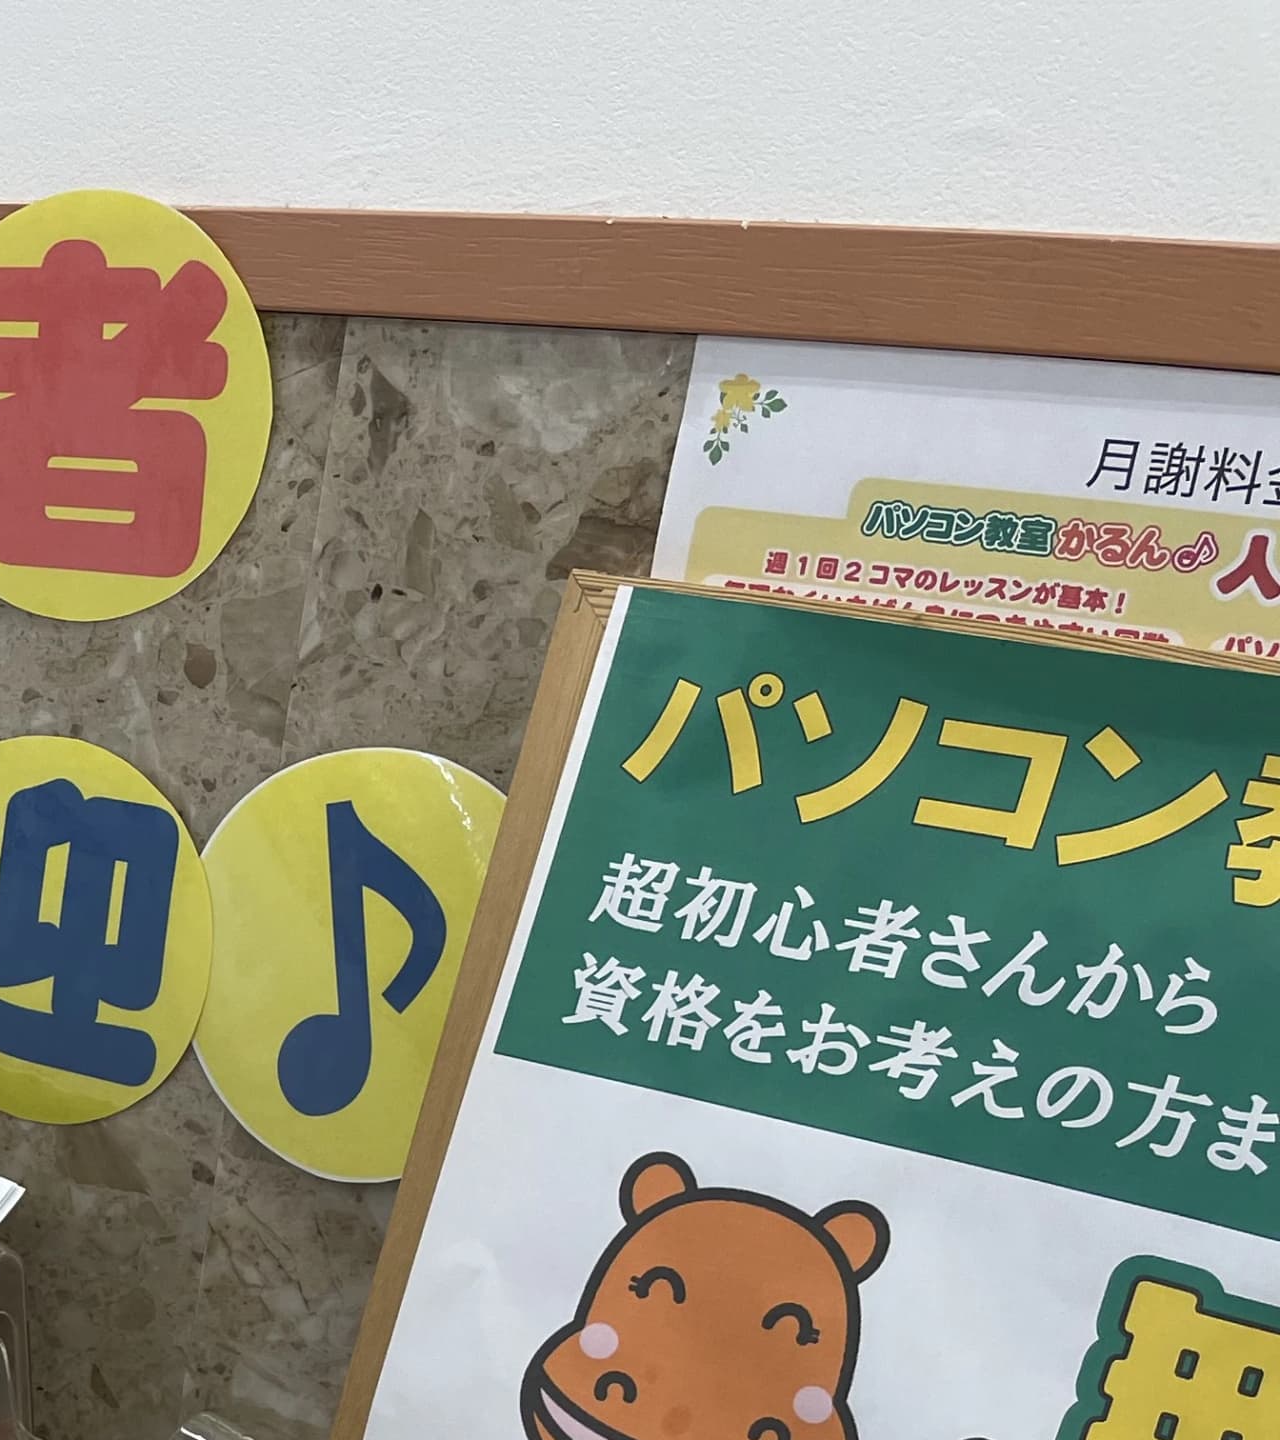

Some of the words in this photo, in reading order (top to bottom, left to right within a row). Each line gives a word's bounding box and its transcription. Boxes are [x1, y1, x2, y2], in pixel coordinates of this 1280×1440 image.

[862, 501, 1058, 555] パソコン教室
[589, 852, 1219, 1034] 超初心者さんから
